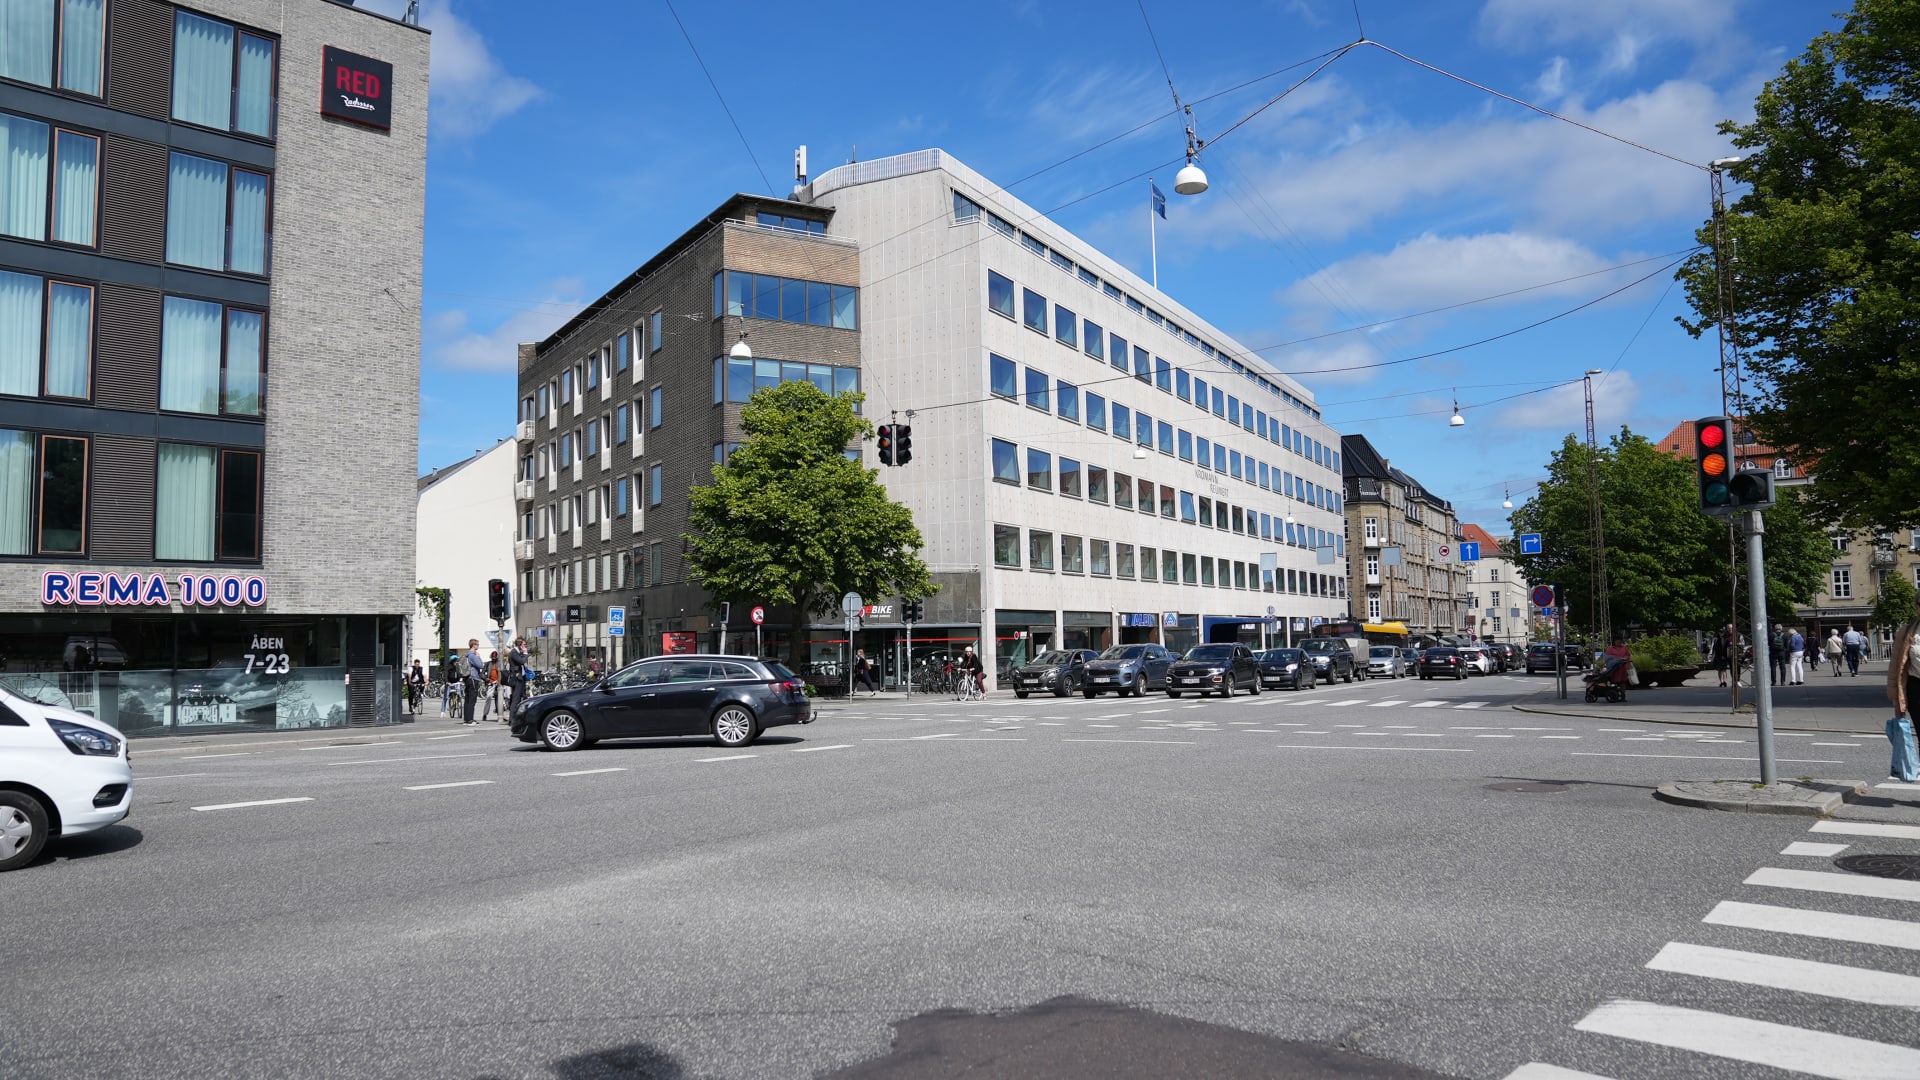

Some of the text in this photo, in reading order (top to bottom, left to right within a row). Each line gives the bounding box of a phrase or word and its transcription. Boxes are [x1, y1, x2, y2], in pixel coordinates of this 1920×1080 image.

[336, 65, 381, 99] RED
[340, 95, 376, 111] Radisson
[42, 571, 267, 607] REMA 1000
[250, 634, 284, 650] ÅBEN
[243, 653, 290, 675] 7-23
